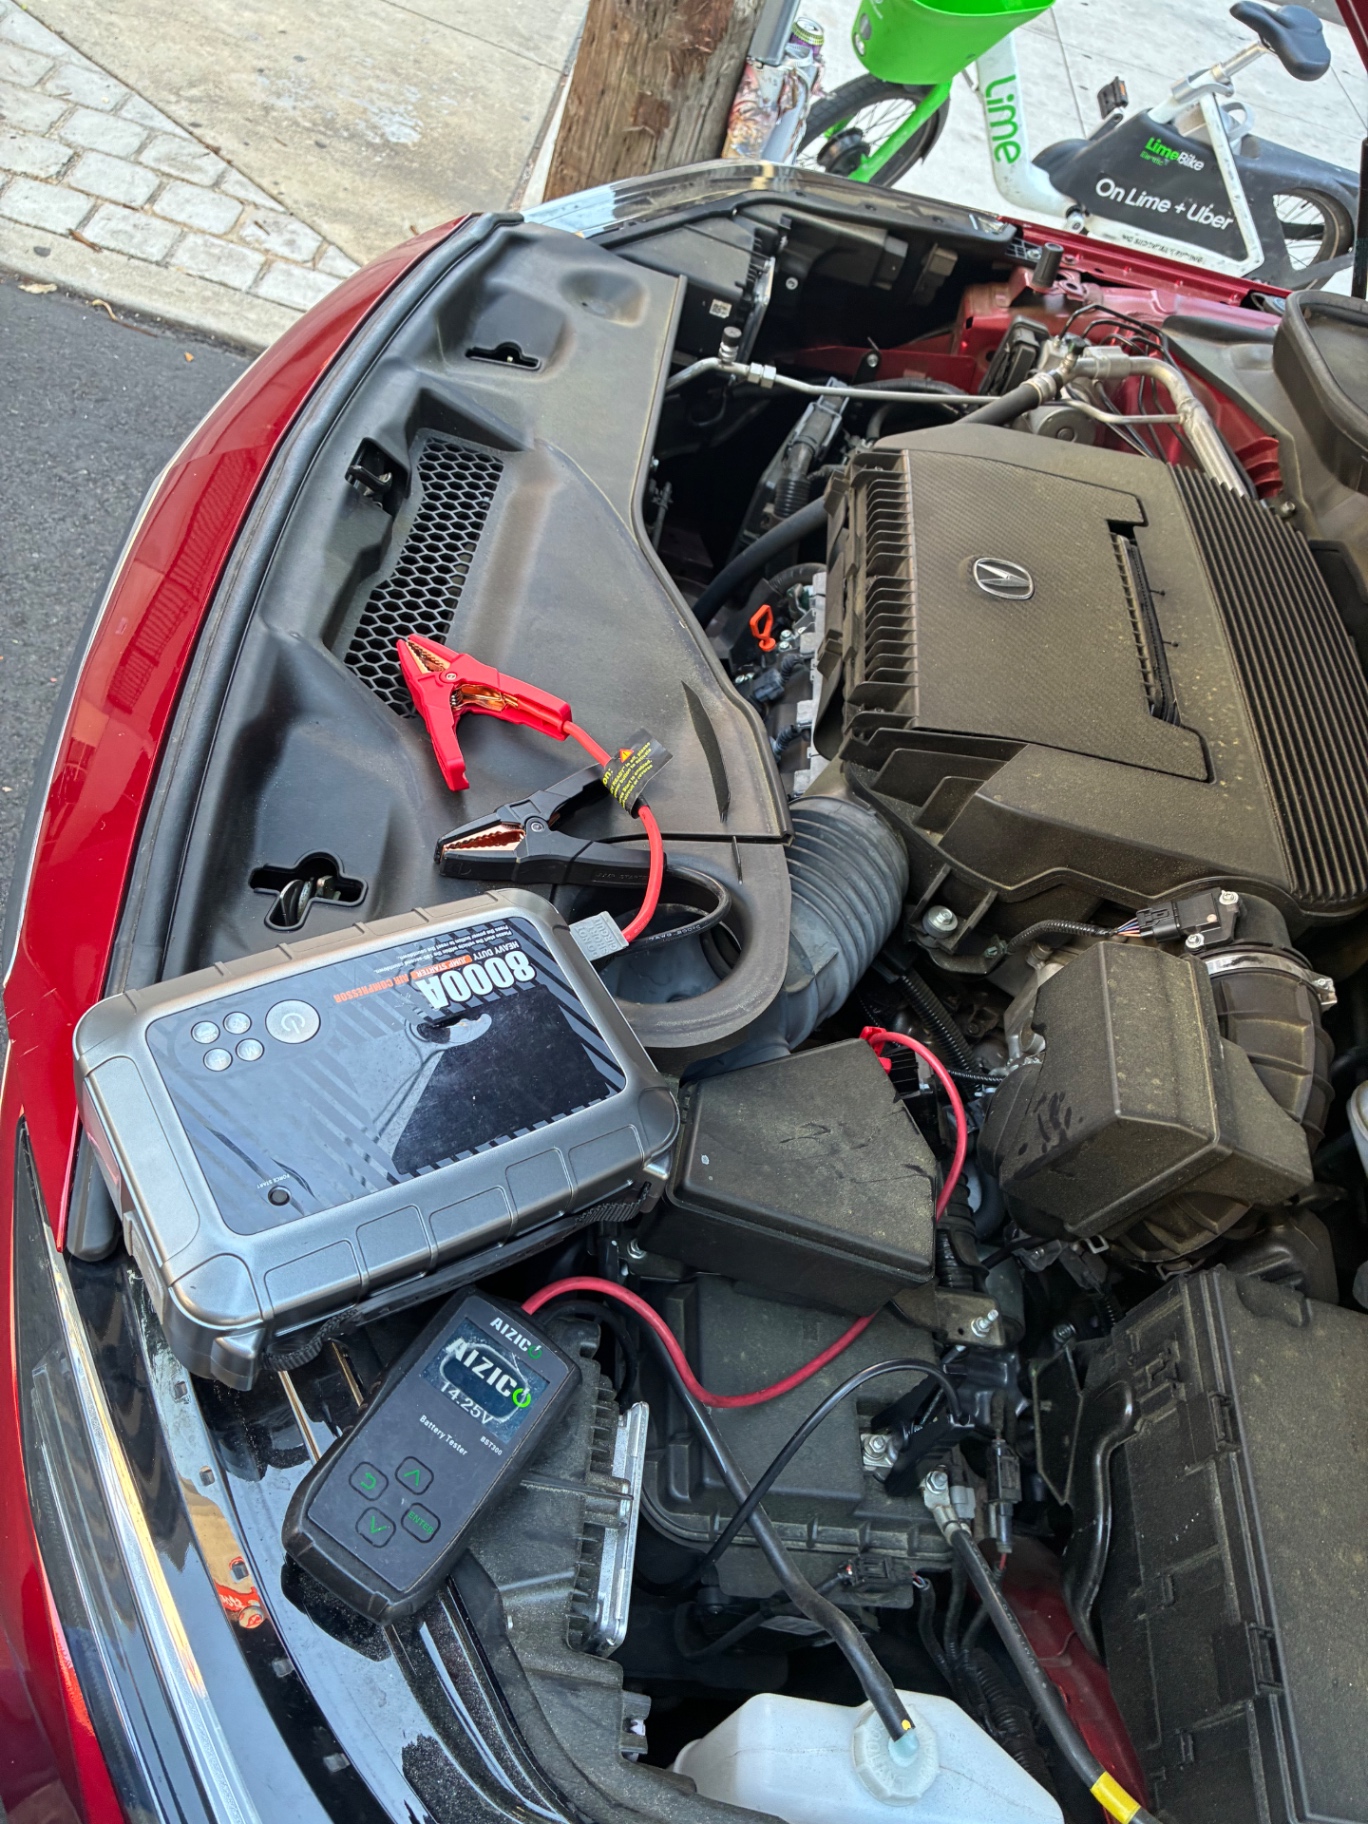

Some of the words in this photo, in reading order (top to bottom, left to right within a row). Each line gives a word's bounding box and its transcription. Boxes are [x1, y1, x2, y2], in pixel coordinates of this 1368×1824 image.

[985, 74, 1021, 164] Lime
[1145, 137, 1204, 171] LimeBike
[1095, 178, 1125, 202] On
[1125, 188, 1171, 213] Lime
[1174, 202, 1186, 214] +
[1186, 203, 1233, 230] Uber
[454, 936, 470, 944] button
[471, 930, 486, 938] power
[586, 926, 608, 954] SHORT
[592, 917, 617, 950] CIRCUIT
[442, 946, 457, 954] within
[457, 940, 475, 948] vehicle
[494, 940, 519, 953] HEAVY
[472, 949, 493, 960] DUTY
[448, 958, 466, 967] JUMP
[415, 963, 446, 977] STARTER
[393, 973, 408, 984] AIR
[415, 950, 535, 1009] 8000A
[333, 978, 393, 1002] COMPRESSOR
[256, 1179, 272, 1188] START
[273, 1173, 289, 1182] FORCE
[440, 1382, 494, 1425] 14.25V
[419, 1414, 446, 1440] Battery
[445, 1435, 468, 1456] Tester
[407, 1511, 434, 1534] ENTER
